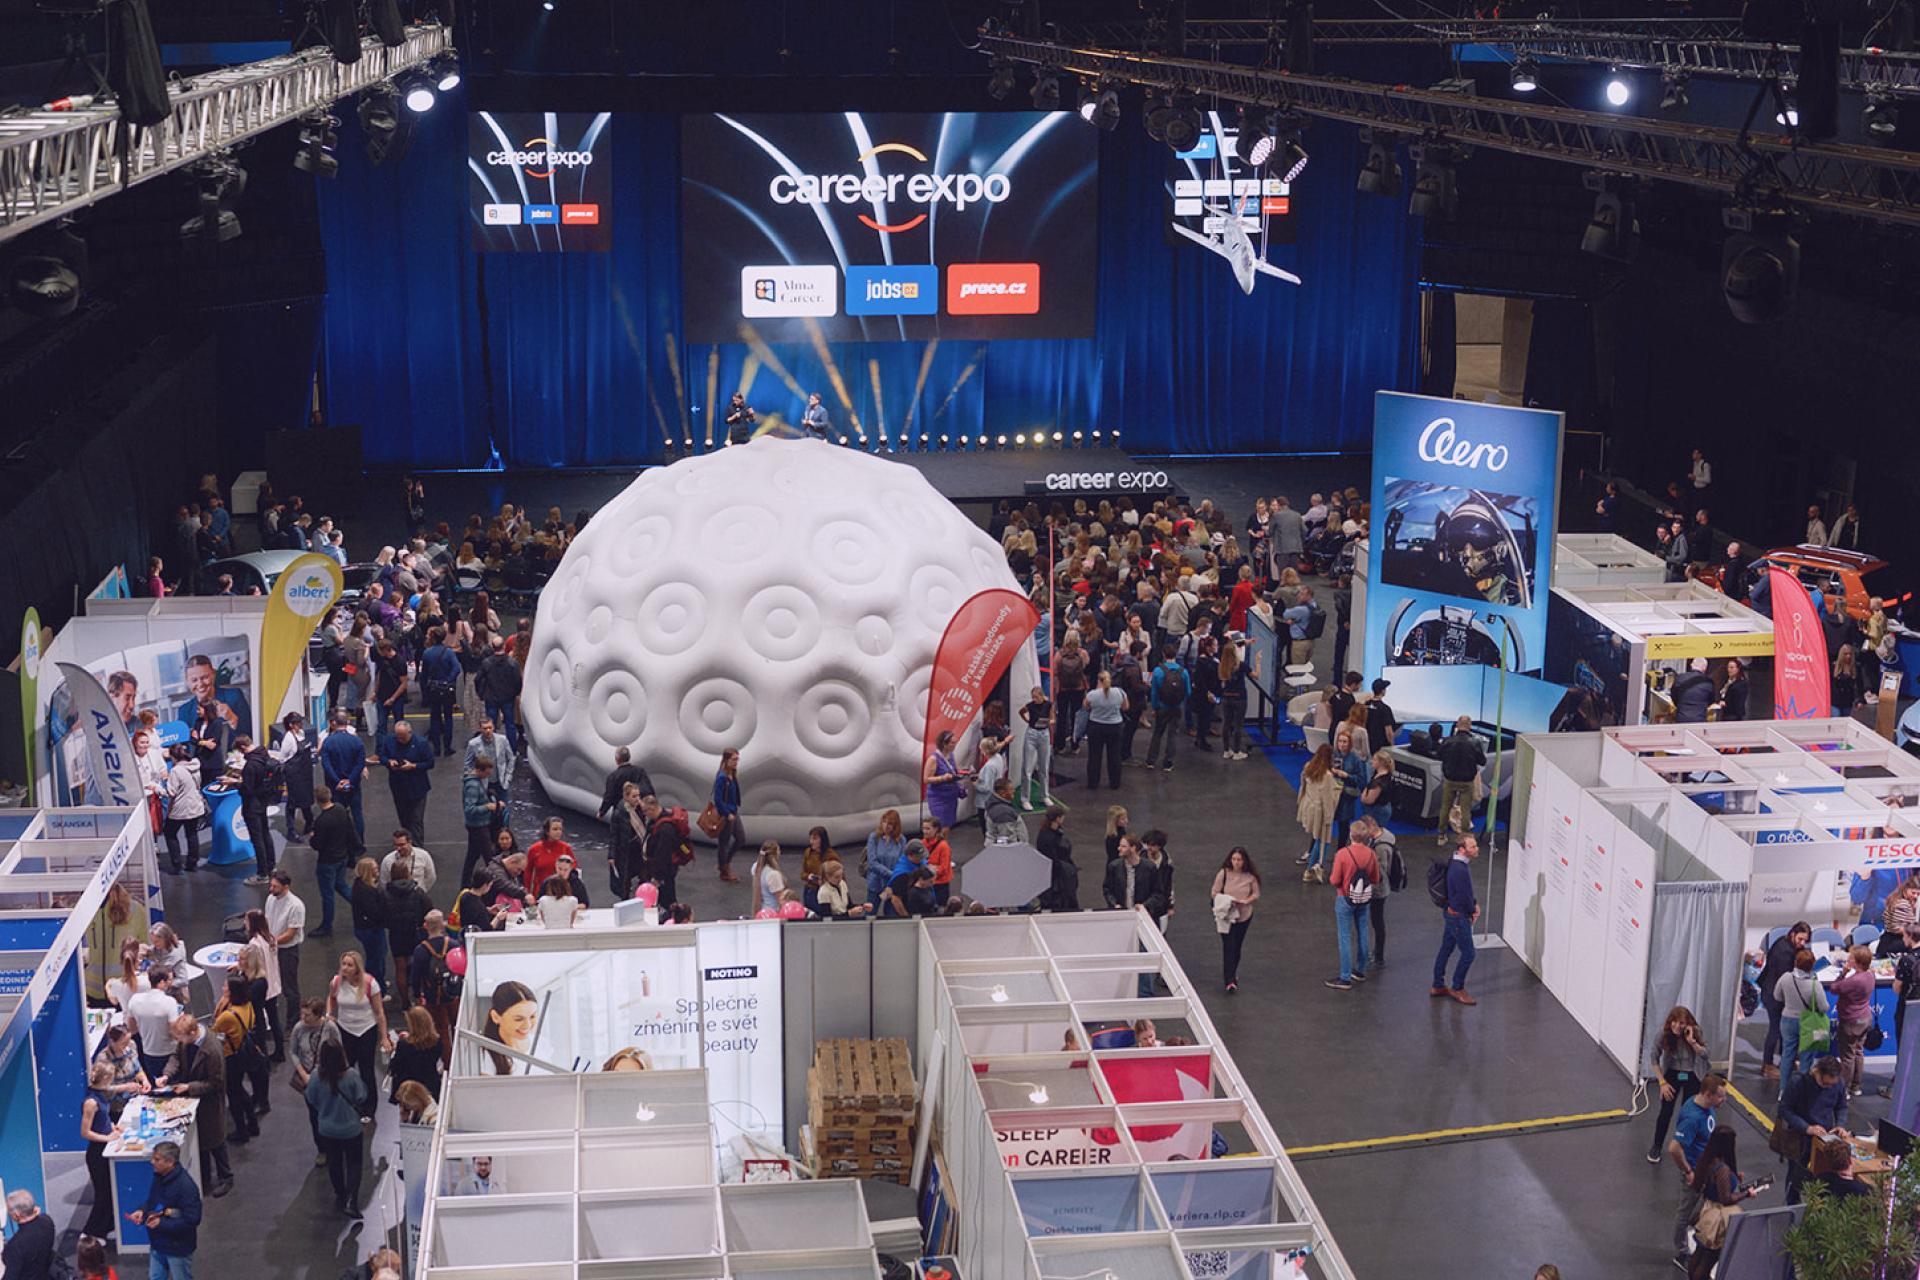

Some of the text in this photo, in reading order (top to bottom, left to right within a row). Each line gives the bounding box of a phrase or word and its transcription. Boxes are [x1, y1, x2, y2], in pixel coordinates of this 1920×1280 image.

[487, 150, 593, 169] career expo
[769, 173, 1010, 211] career expo
[783, 279, 814, 291] Alma
[960, 281, 1028, 299] prace.cz
[1418, 417, 1509, 472] Aero
[1045, 471, 1168, 493] career expo
[288, 584, 330, 600] albert
[961, 604, 1011, 685] Pražské vodovody
[977, 634, 1005, 682] kanalizace
[1766, 833, 1776, 843] o
[710, 968, 753, 979] NOTINO
[721, 1013, 759, 1031] svět
[997, 1128, 1059, 1142] SLEEP
[1003, 1154, 1019, 1167] n
[1169, 1209, 1246, 1221] kariera.rlp.cz
